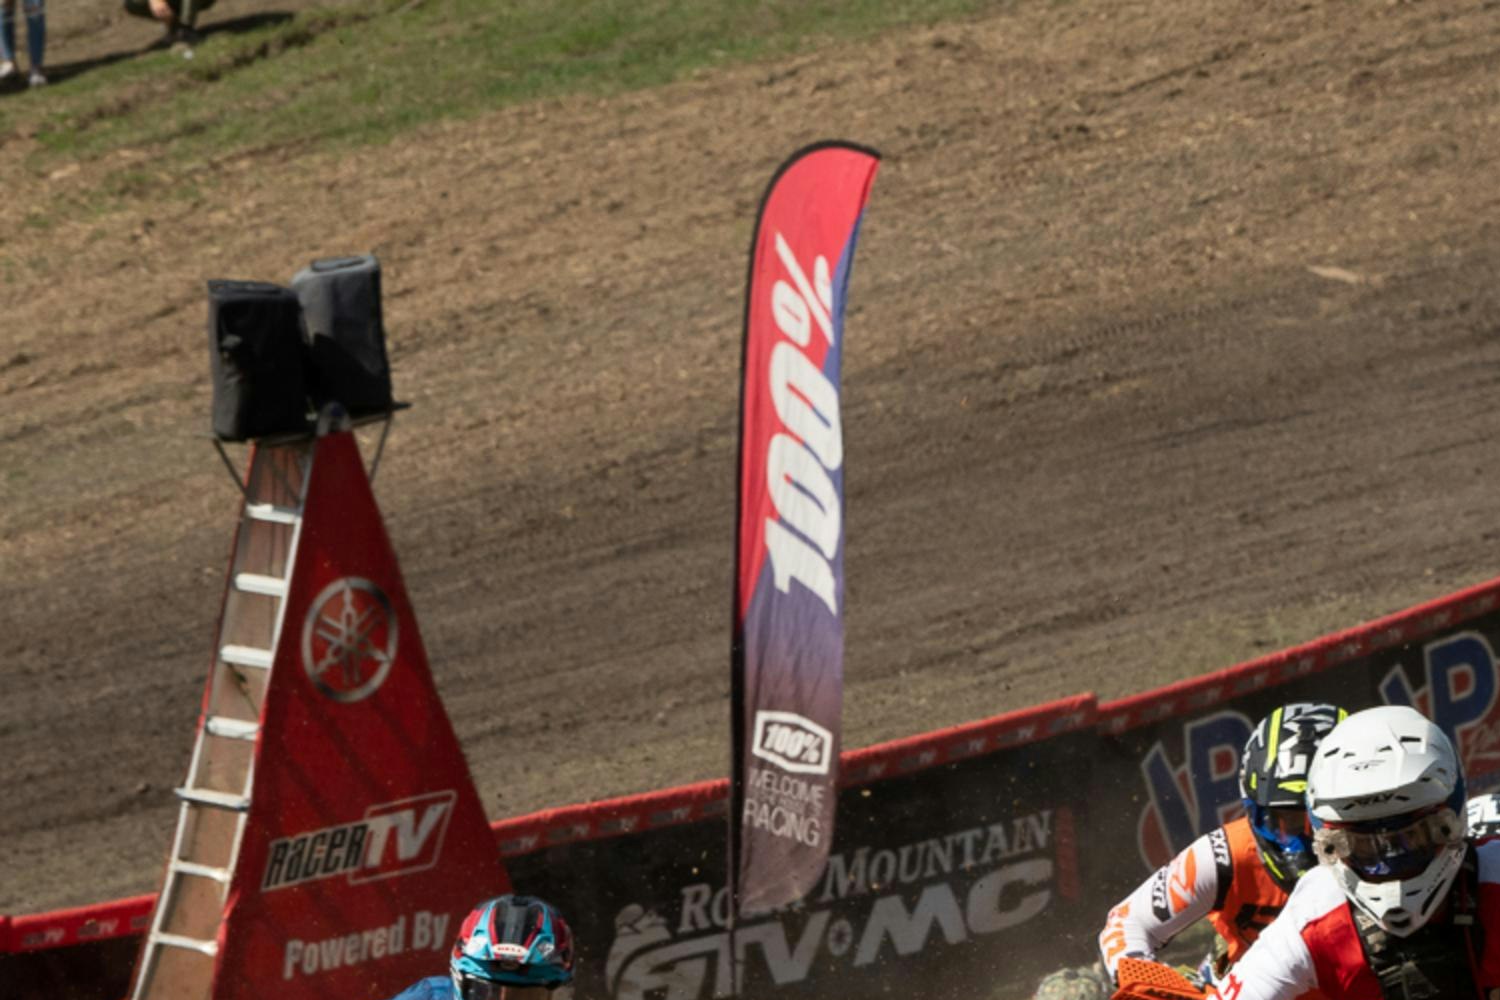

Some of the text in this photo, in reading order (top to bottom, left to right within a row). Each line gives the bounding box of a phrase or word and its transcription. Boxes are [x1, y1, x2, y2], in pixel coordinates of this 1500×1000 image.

[765, 231, 844, 616] 100%
[763, 722, 823, 764] 100%
[743, 797, 820, 848] RACING
[824, 809, 1053, 902] MOUNTAIN
[283, 910, 451, 980] Powered By
[853, 858, 1054, 968] MC
